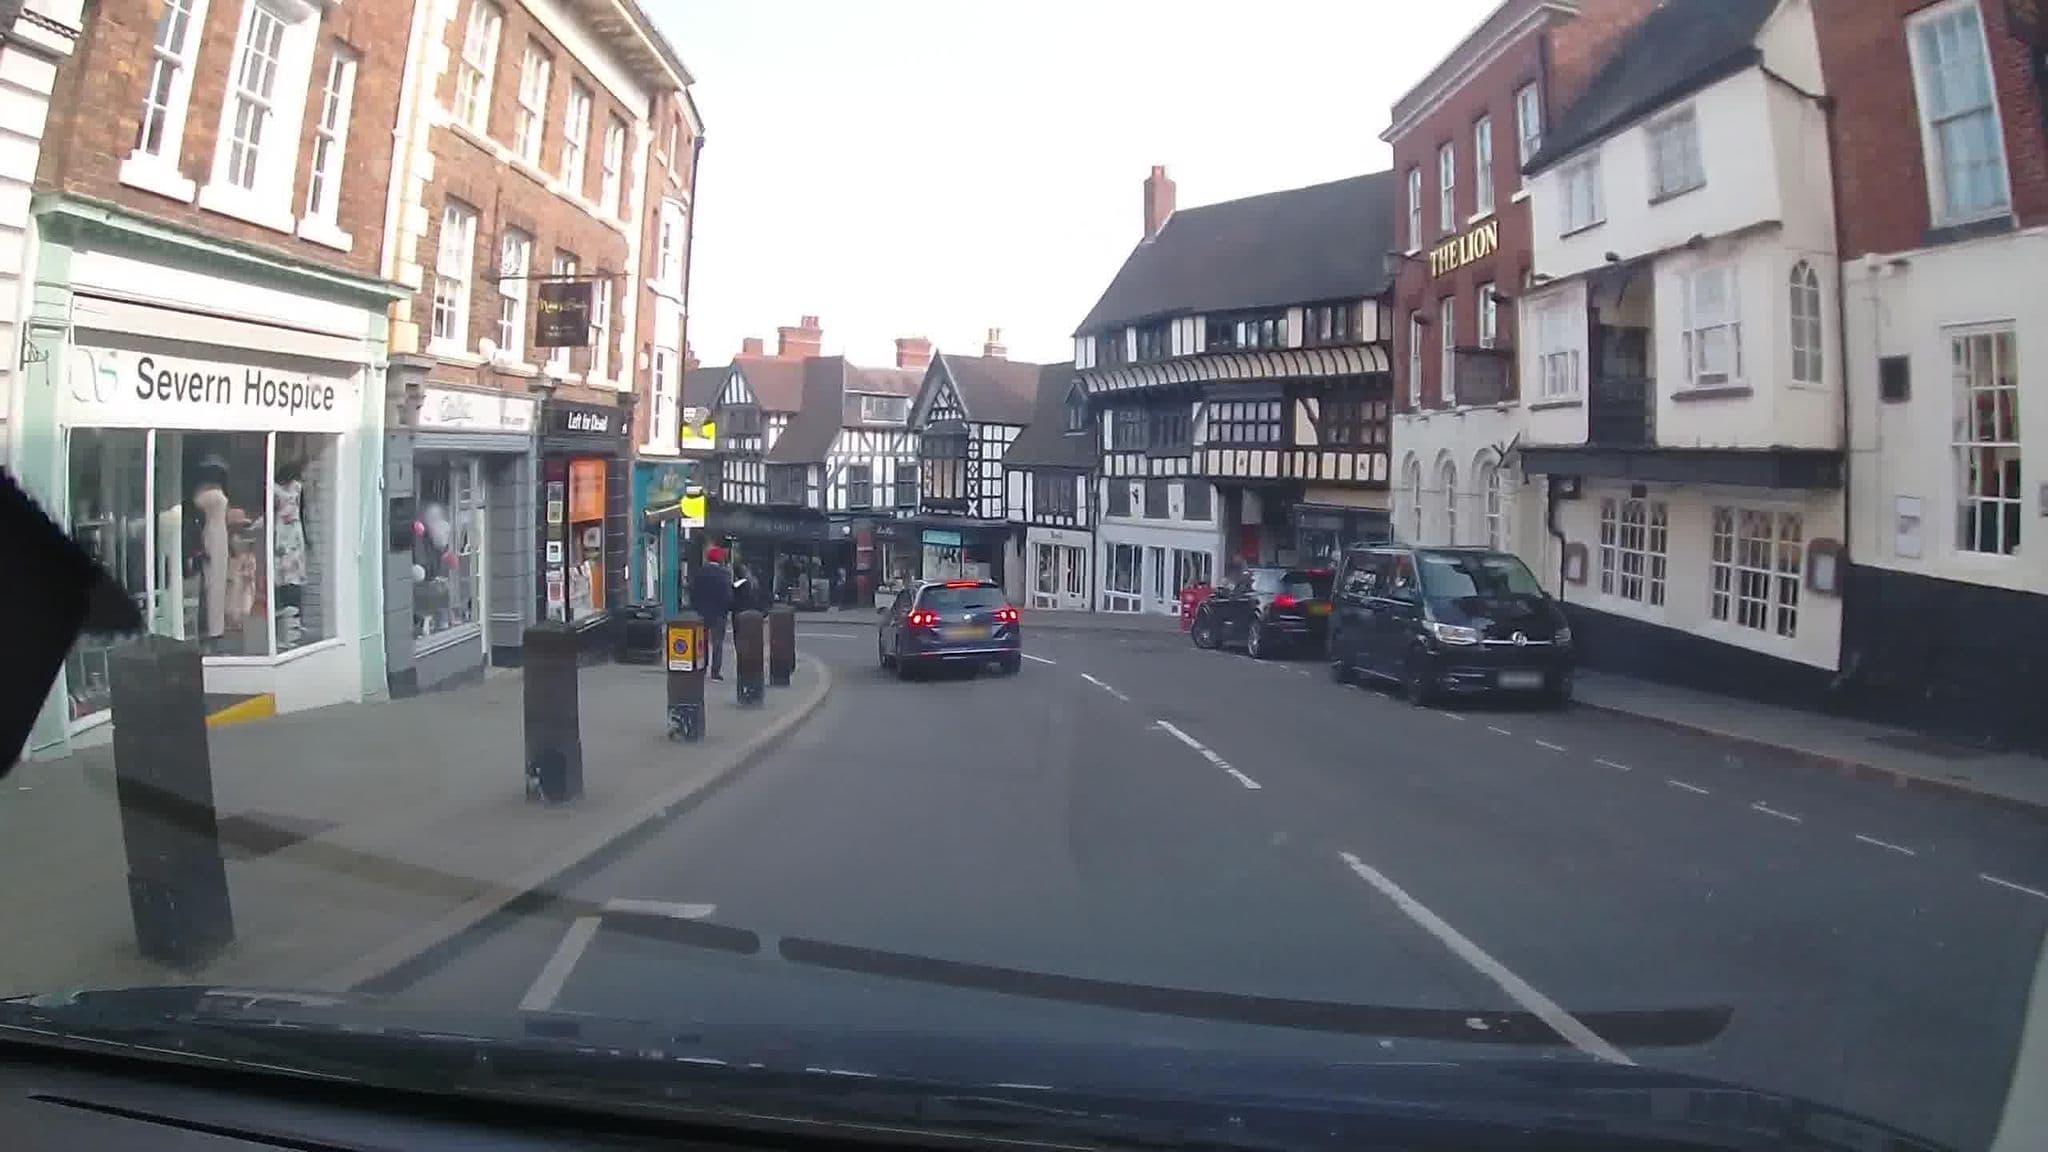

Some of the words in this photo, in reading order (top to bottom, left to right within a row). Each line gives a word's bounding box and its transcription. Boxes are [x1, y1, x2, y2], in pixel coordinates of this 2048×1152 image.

[1430, 240, 1458, 277] THE
[1460, 220, 1498, 265] LION
[136, 357, 231, 405] Severn
[244, 368, 335, 416] Hospice
[567, 411, 582, 430] Left
[582, 412, 591, 431] for
[590, 413, 609, 432] Dead
